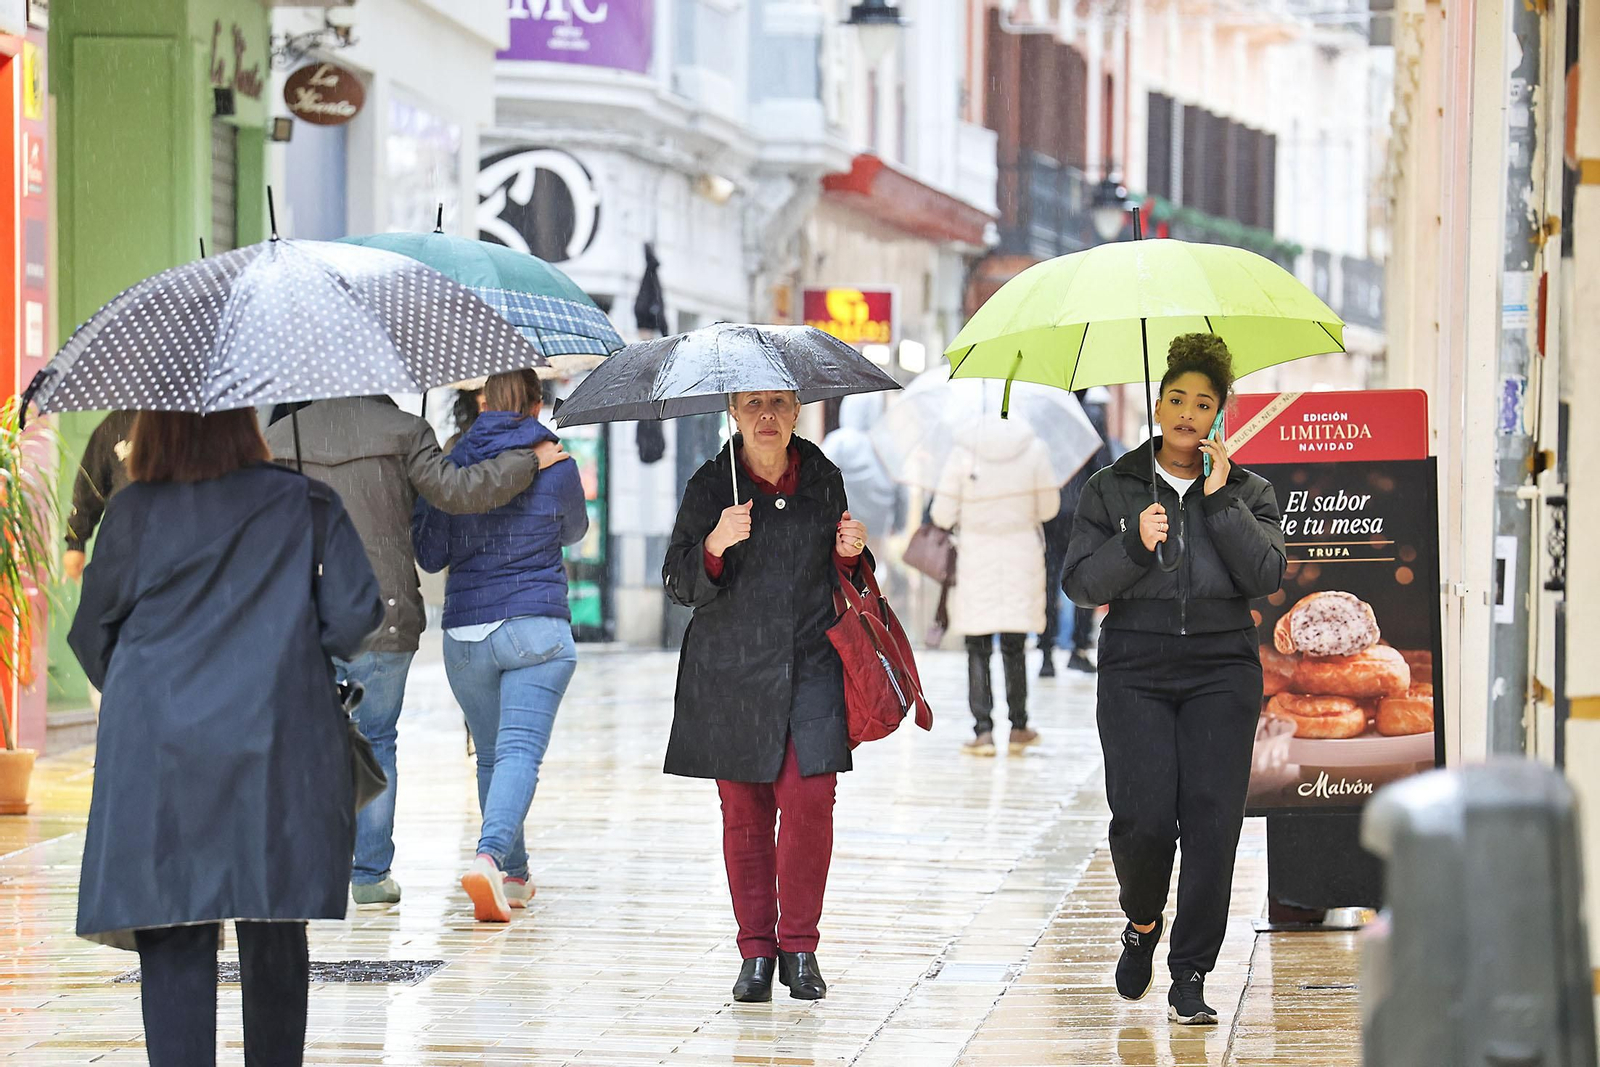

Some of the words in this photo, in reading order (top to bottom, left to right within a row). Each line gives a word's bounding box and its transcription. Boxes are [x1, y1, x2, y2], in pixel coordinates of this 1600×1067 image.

[1233, 423, 1258, 445] NUEVA
[1261, 404, 1278, 421] NEW
[1303, 411, 1348, 422] EDICIÓN
[1280, 423, 1372, 441] LIMITADA
[1299, 442, 1354, 452] NAVIDAD
[1285, 490, 1309, 513] El
[1312, 489, 1371, 512] sabor
[1303, 516, 1325, 536] tu
[1330, 517, 1384, 535] mesa
[1308, 547, 1350, 557] TRUFA
[1297, 770, 1374, 799] Malvón
